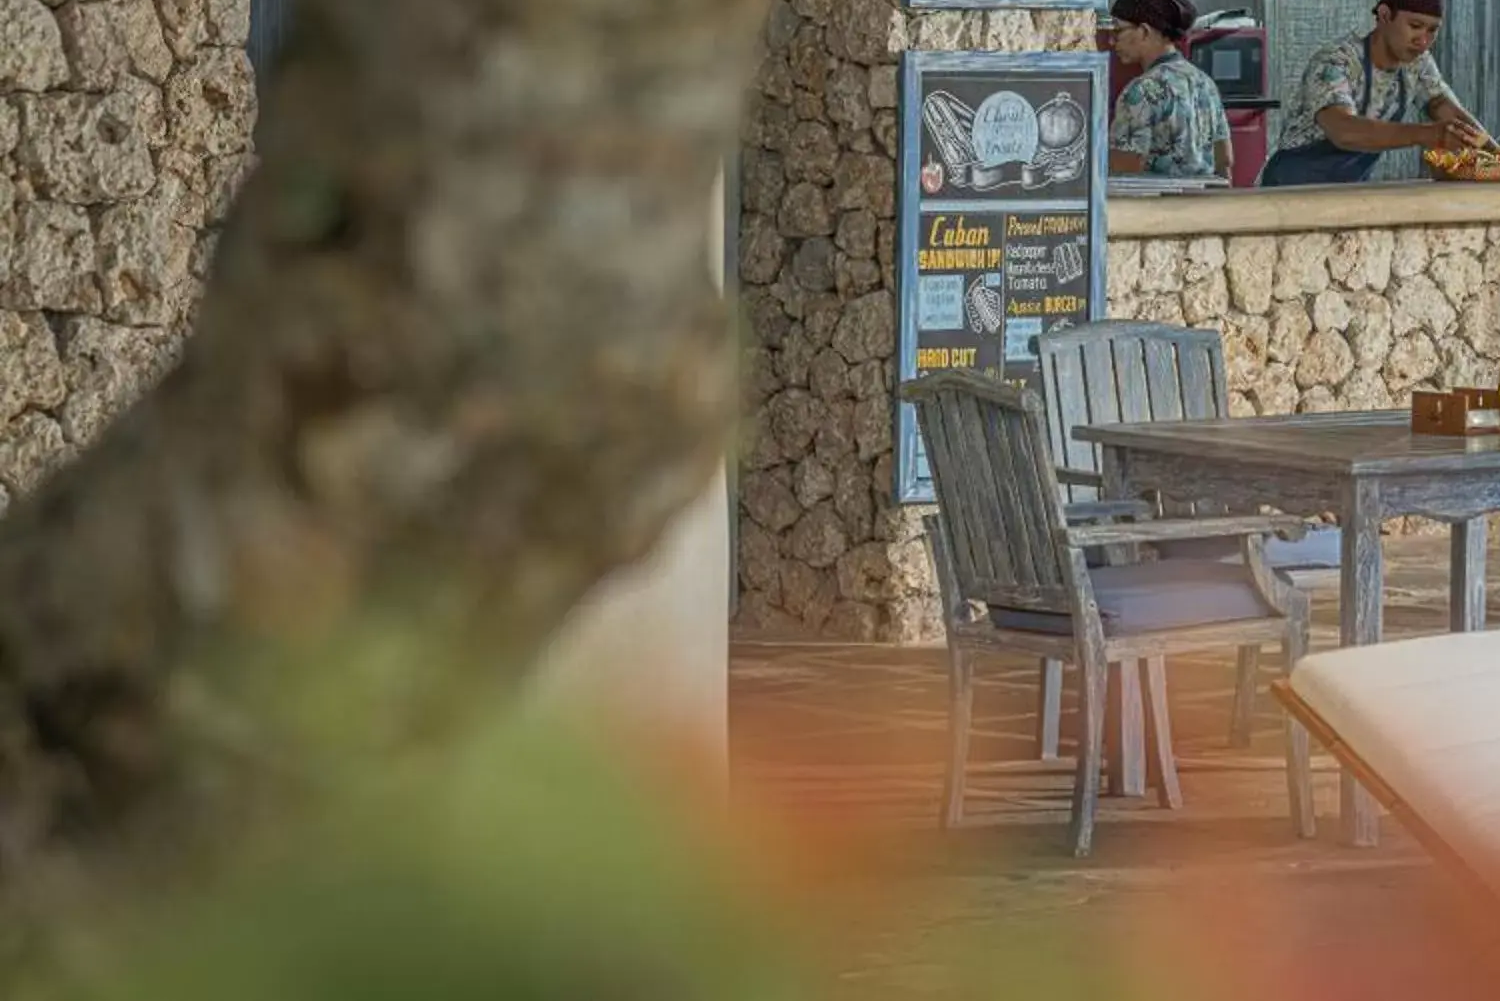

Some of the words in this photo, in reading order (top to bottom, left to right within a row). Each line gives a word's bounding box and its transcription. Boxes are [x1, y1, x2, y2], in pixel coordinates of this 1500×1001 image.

[929, 215, 990, 247] Cuban
[918, 248, 984, 270] SANDWICH
[1007, 277, 1048, 292] Tomato
[950, 347, 977, 367] CUT
